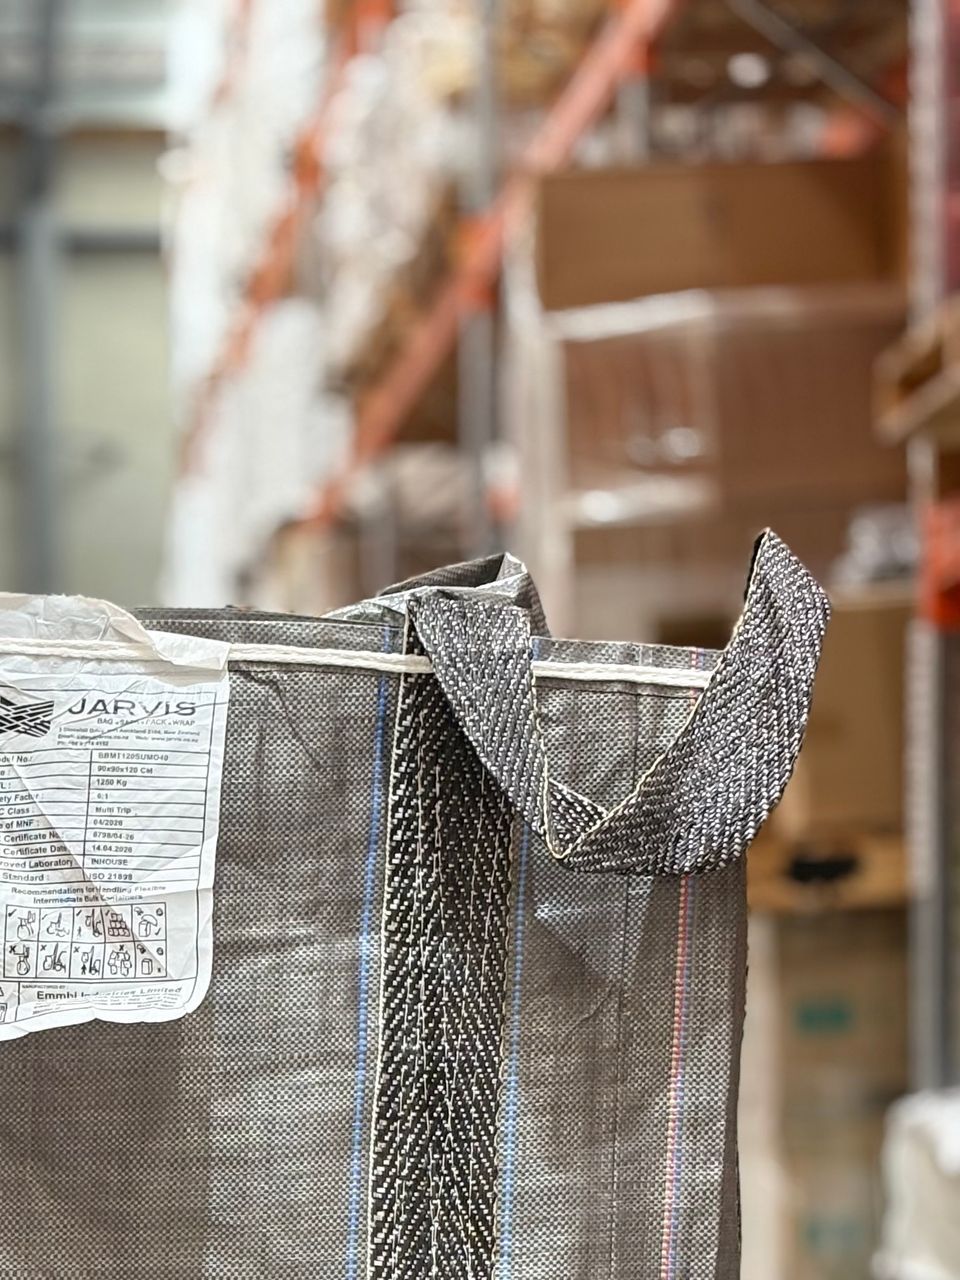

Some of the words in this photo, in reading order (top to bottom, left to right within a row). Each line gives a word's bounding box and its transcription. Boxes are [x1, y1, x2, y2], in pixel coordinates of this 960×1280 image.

[68, 698, 196, 716] JARVIS
[96, 778, 114, 786] 1250
[116, 779, 128, 787] Kg
[7, 806, 30, 815] Class
[116, 806, 132, 815] Trip
[5, 821, 15, 829] of
[16, 819, 34, 827] MNF
[3, 832, 47, 842] Certificate
[3, 846, 48, 855] Certificate
[28, 859, 74, 868] Laboratory
[91, 858, 129, 866] INHOUSE
[2, 871, 44, 881] Standard
[11, 887, 84, 895] Recommendations
[84, 895, 99, 903] Bulk
